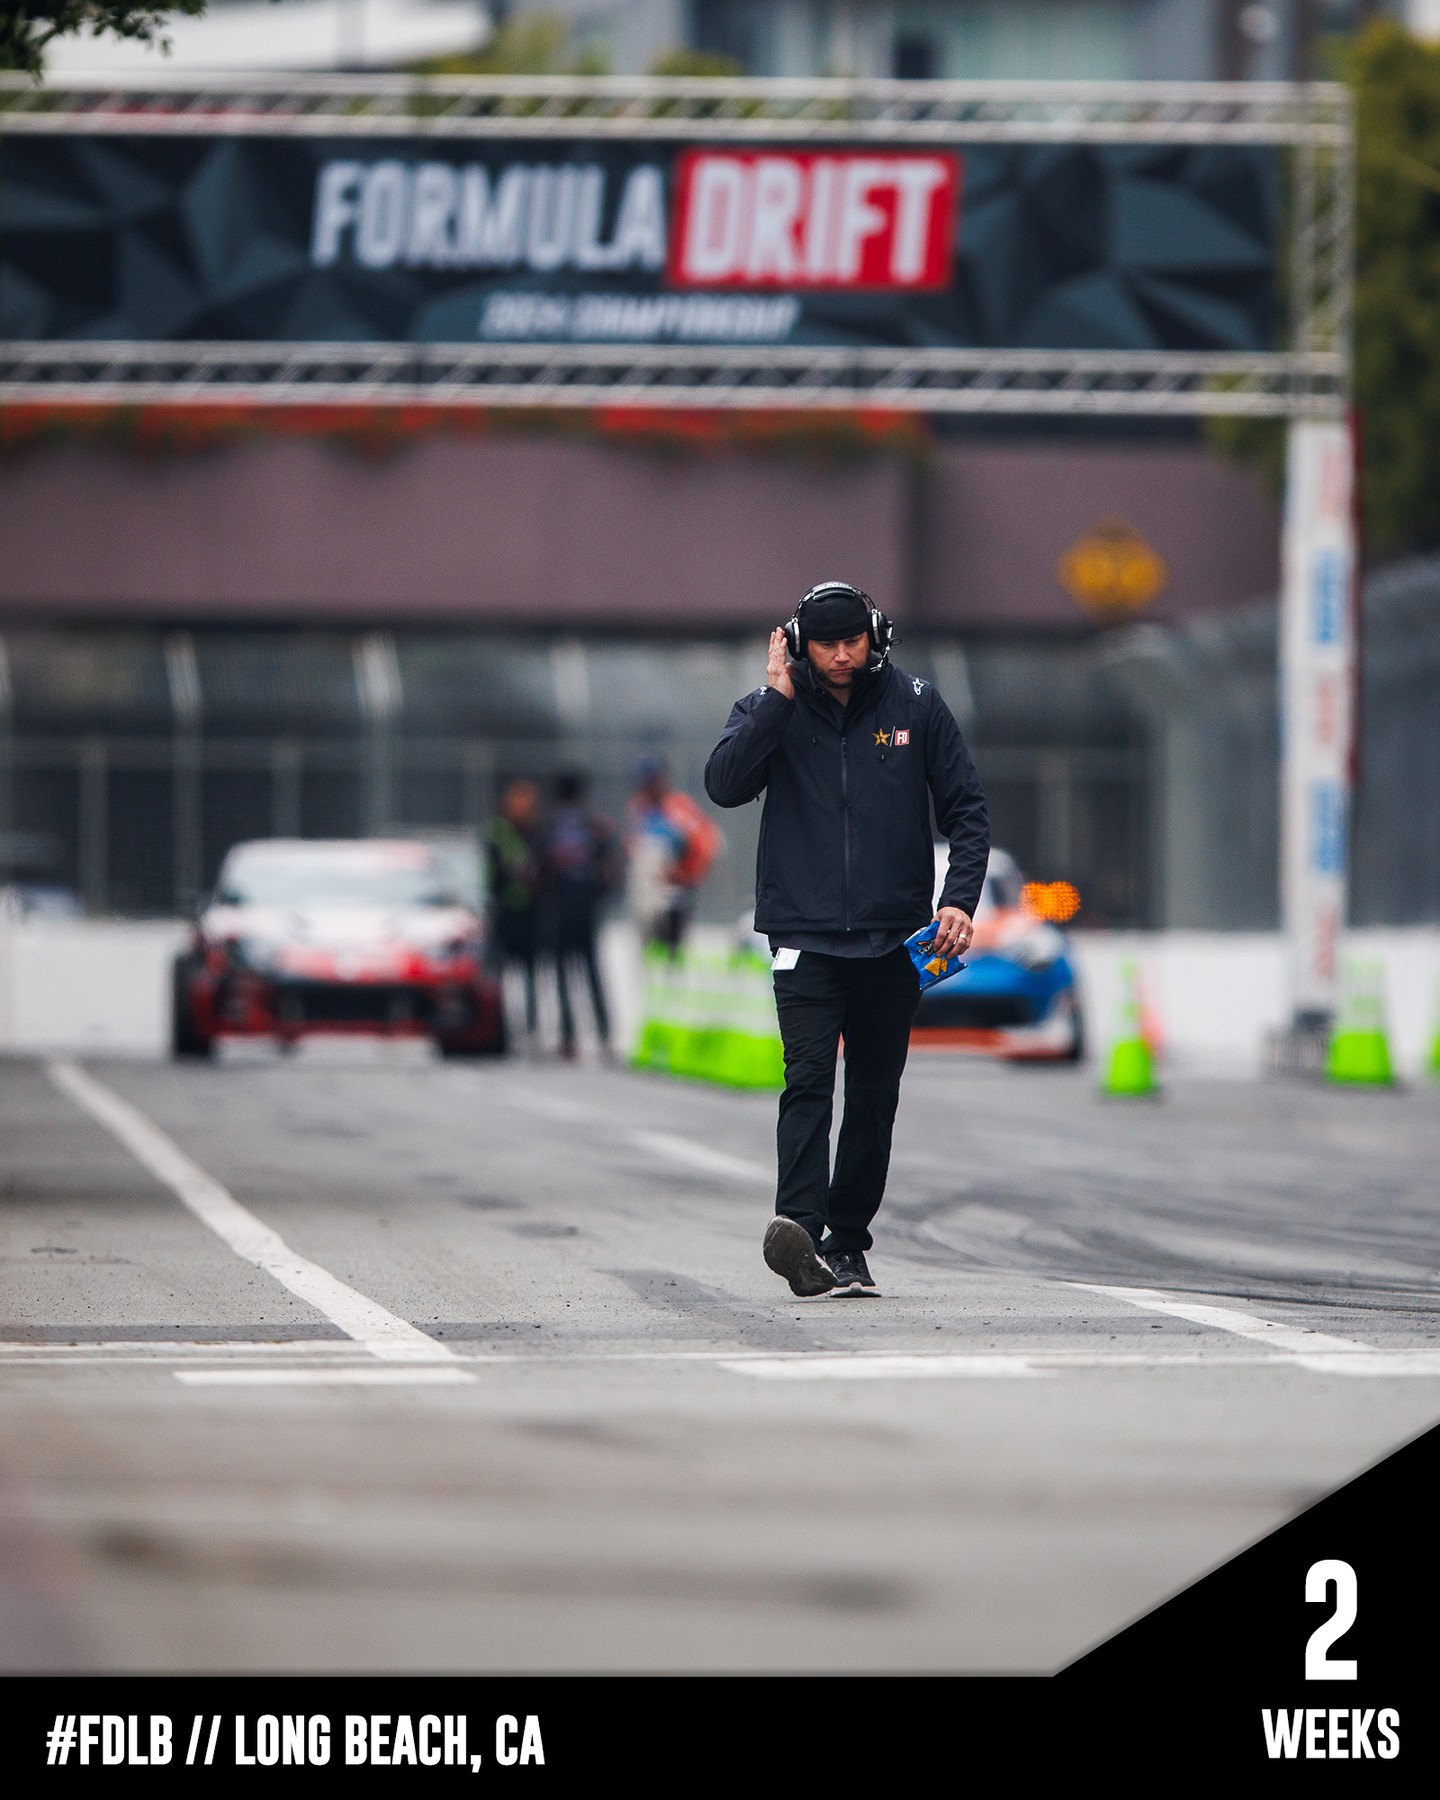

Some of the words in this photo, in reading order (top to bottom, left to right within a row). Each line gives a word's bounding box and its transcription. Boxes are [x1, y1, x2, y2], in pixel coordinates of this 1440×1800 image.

[312, 159, 668, 270] FORMULA
[683, 154, 945, 284] DRIFT
[897, 730, 908, 744] FD
